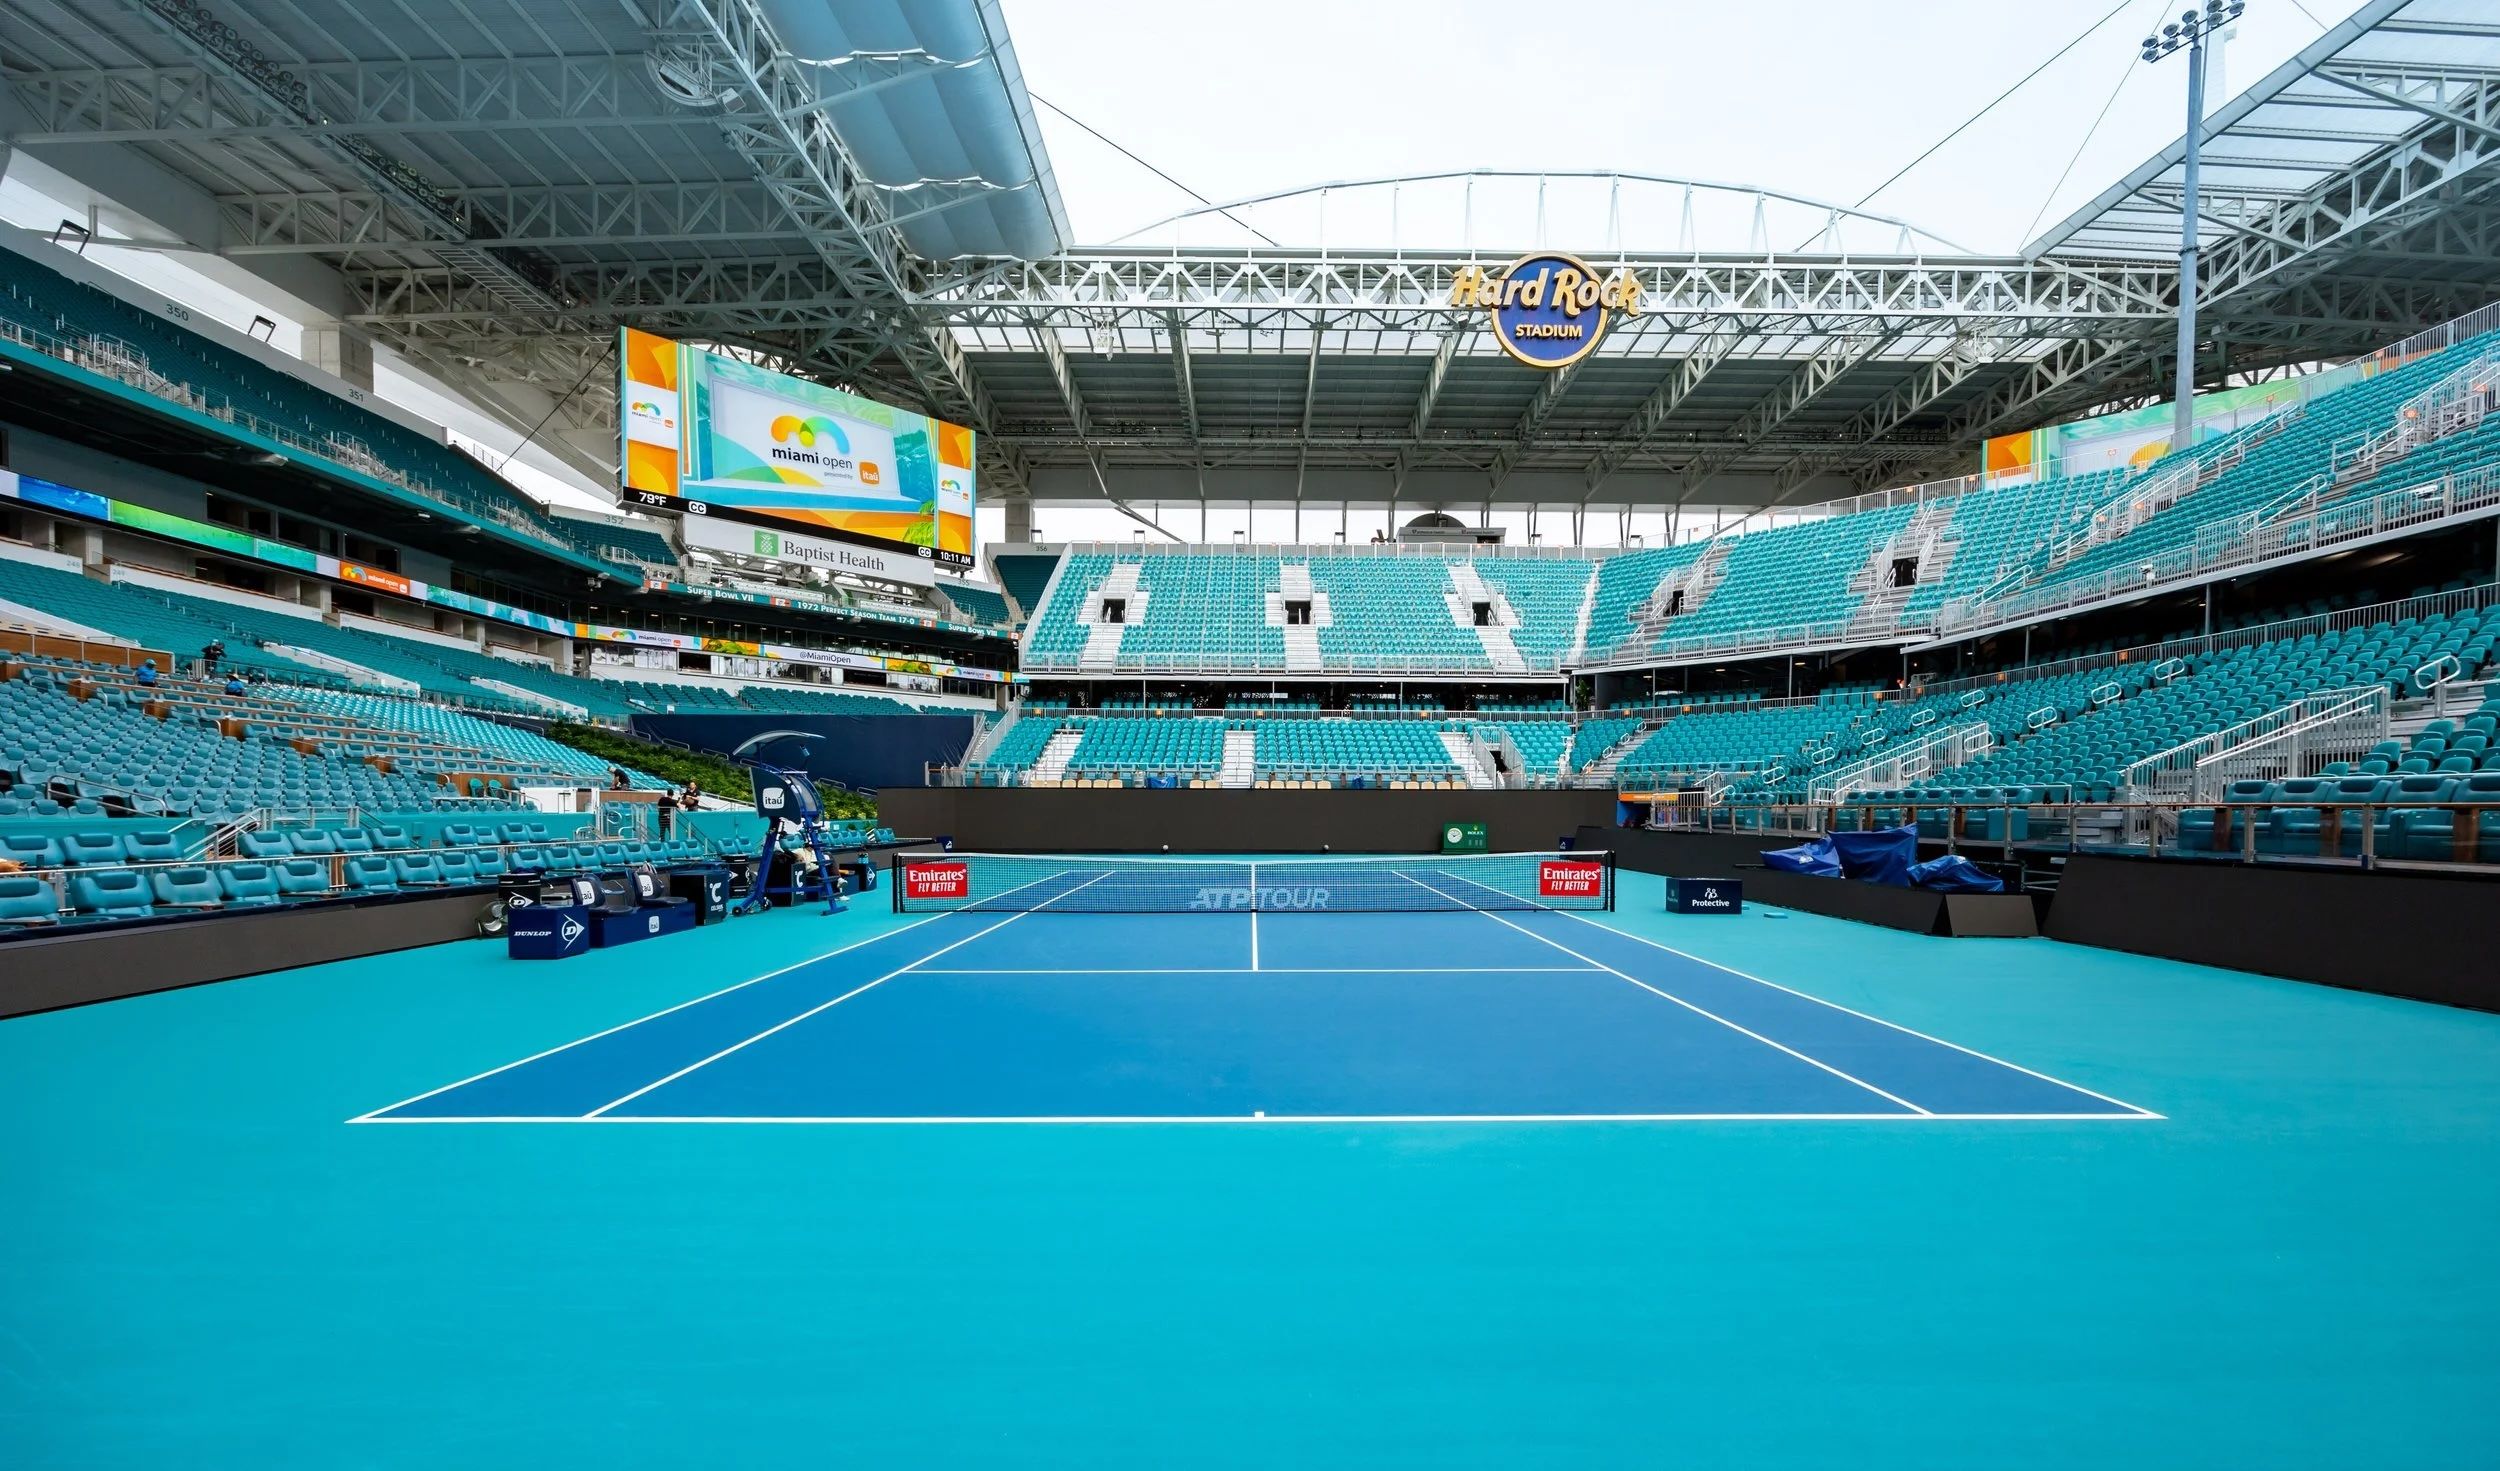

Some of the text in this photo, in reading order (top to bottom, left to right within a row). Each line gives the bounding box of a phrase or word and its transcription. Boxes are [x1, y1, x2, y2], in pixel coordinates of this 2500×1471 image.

[1451, 266, 1643, 317] Hard Rock
[166, 303, 189, 321] 350
[1515, 323, 1583, 339] STADIUM
[348, 388, 364, 402] 351
[771, 447, 853, 470] miami open
[639, 491, 667, 506] 79°F
[690, 503, 705, 512] CC
[605, 514, 625, 526] 352
[784, 540, 885, 571] Baptist Health
[919, 548, 930, 556] CC
[940, 551, 971, 565] 10:11 AM
[687, 586, 754, 602] SUPER BOWL VII
[797, 601, 915, 625] 1972 PERFECT SEASON TEAM 17-0
[948, 623, 967, 633] SUPER
[968, 626, 985, 635] BOWL
[657, 636, 672, 644] open
[800, 651, 851, 664] @MiamiOpen
[765, 791, 784, 805] itaú
[909, 870, 964, 882] Emirates
[1543, 868, 1598, 880] Emirates
[918, 881, 957, 892] FLY BETTER
[1551, 881, 1590, 891] FLY BETTER
[1189, 887, 1331, 910] ATP TOUR
[1692, 899, 1730, 907] Protective
